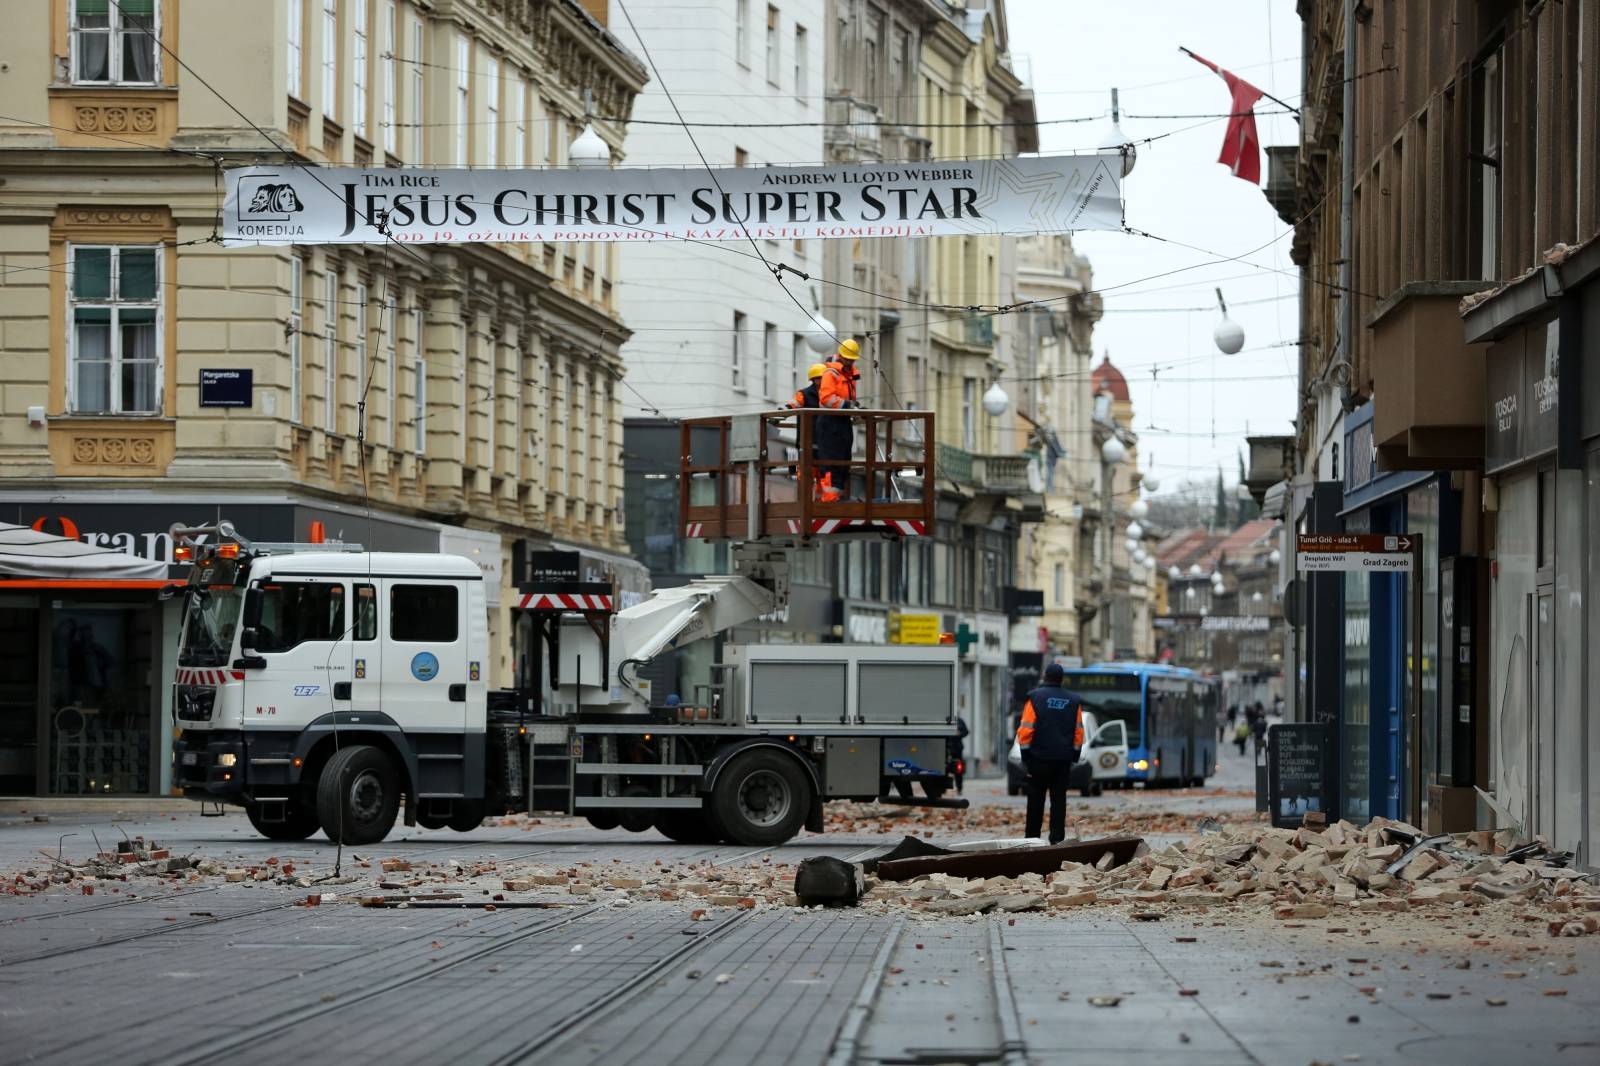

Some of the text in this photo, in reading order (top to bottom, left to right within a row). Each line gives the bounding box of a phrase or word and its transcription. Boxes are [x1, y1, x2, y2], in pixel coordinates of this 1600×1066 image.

[361, 174, 440, 188] TIM RICE
[762, 168, 973, 185] ANDREW LLOYD WEBBER
[339, 183, 982, 237] JESUS CHRIST SUPER STAR
[237, 225, 304, 236] KOMEDIJA
[433, 231, 458, 241] 19.
[554, 231, 655, 241] PONOVNO
[1495, 394, 1517, 419] TOSCA
[1539, 397, 1552, 414] BLU
[1499, 416, 1512, 432] BLU
[1299, 536, 1318, 544] Tunel
[1353, 536, 1357, 544] 4
[1363, 558, 1409, 568] Grad Zagreb
[293, 685, 320, 696] ZET
[256, 706, 262, 714] M
